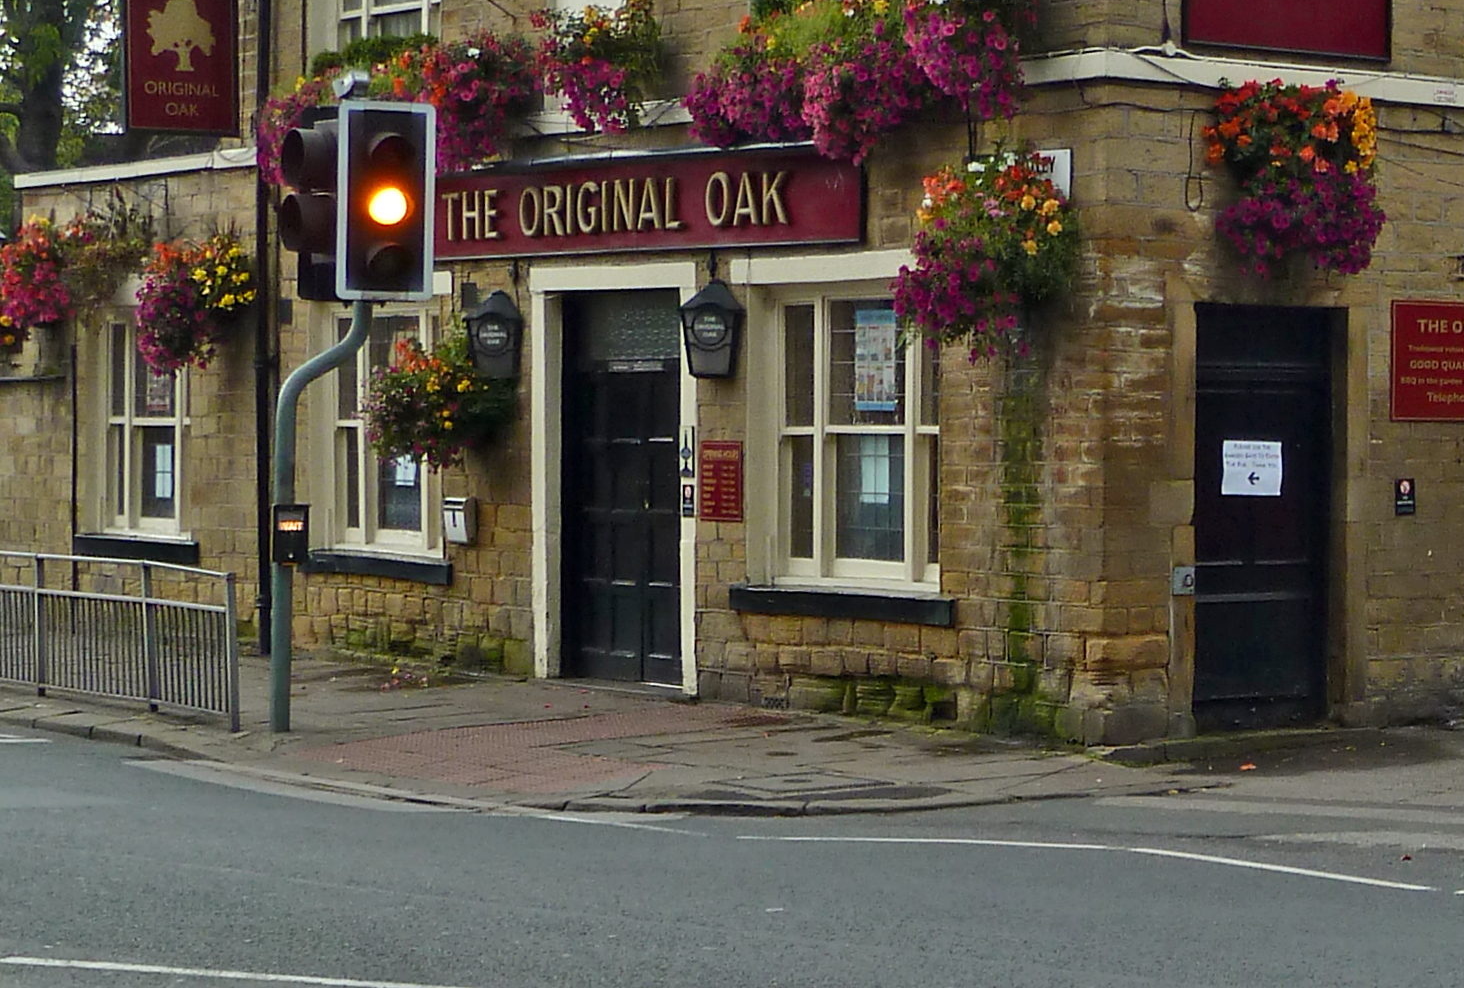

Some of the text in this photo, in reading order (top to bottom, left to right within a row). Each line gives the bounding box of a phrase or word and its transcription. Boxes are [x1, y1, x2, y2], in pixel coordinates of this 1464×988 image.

[144, 80, 219, 97] ORIGINAL
[165, 102, 199, 116] OAK
[441, 170, 789, 241] THE ORIGINAL OAK
[1417, 318, 1448, 333] THE
[1410, 359, 1439, 370] GOOD
